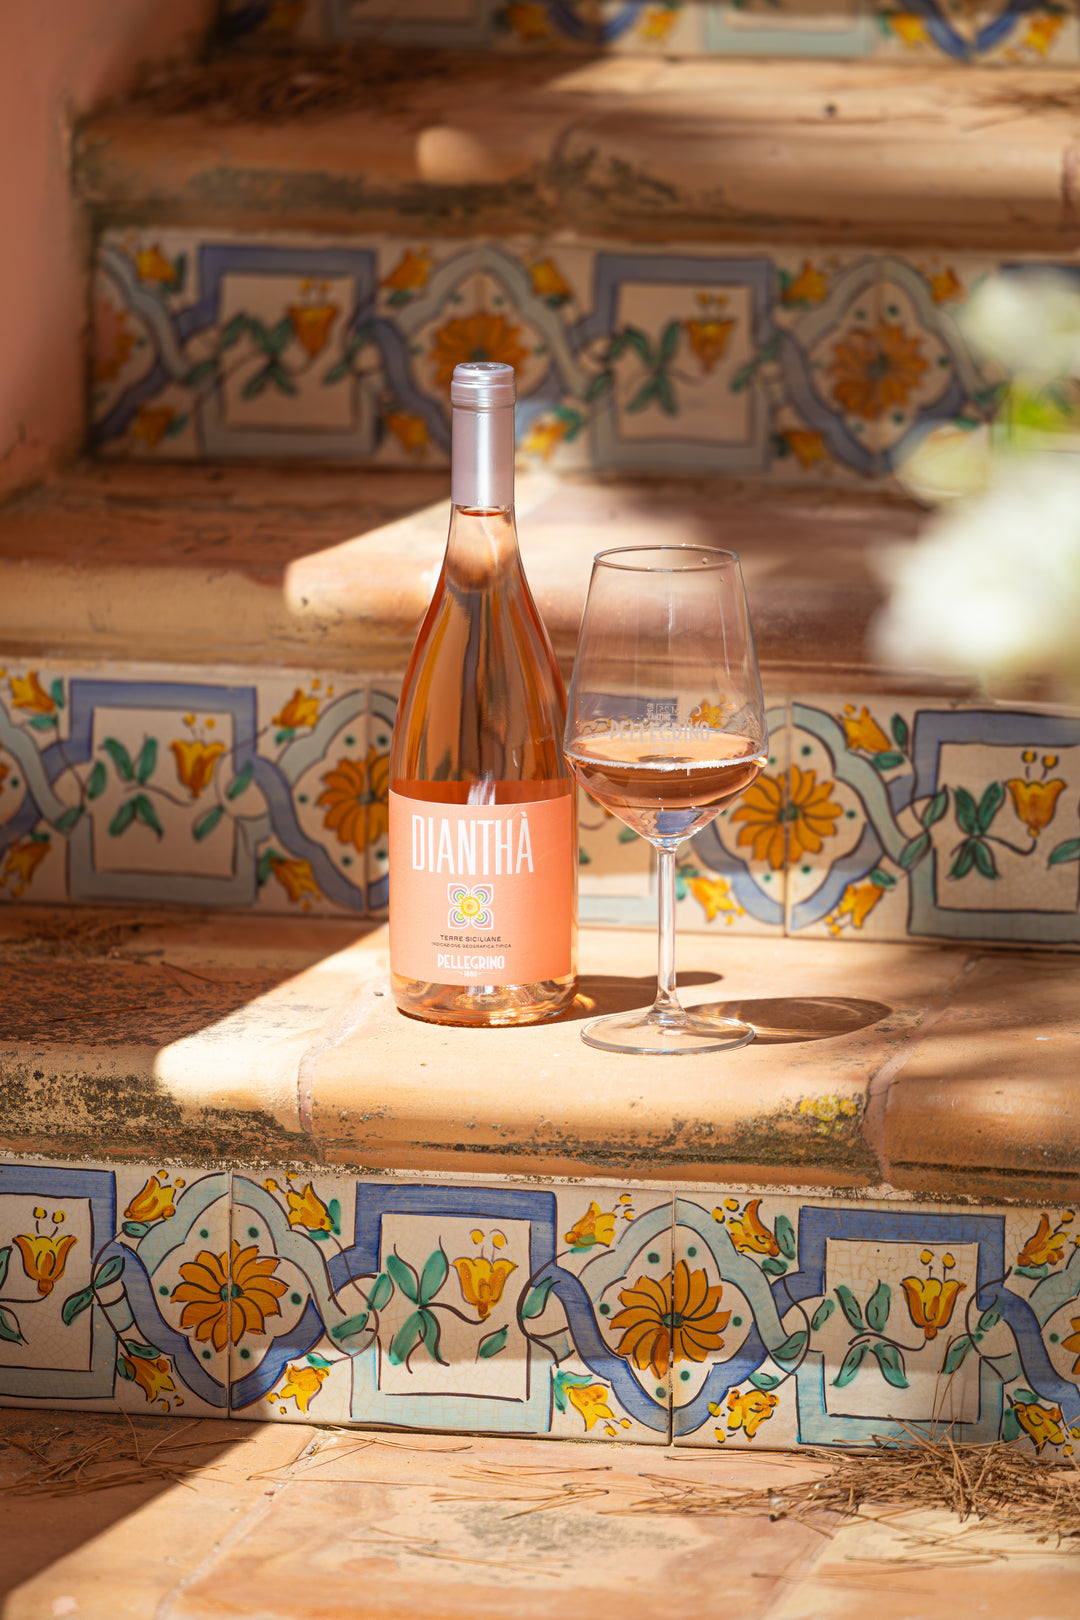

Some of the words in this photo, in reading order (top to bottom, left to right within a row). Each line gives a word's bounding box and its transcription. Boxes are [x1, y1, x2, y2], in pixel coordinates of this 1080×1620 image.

[610, 720, 710, 744] PELLEGRINO
[649, 746, 670, 755] 1880
[411, 811, 534, 875] DIANTHÀ
[437, 953, 505, 970] PELLEGRINO
